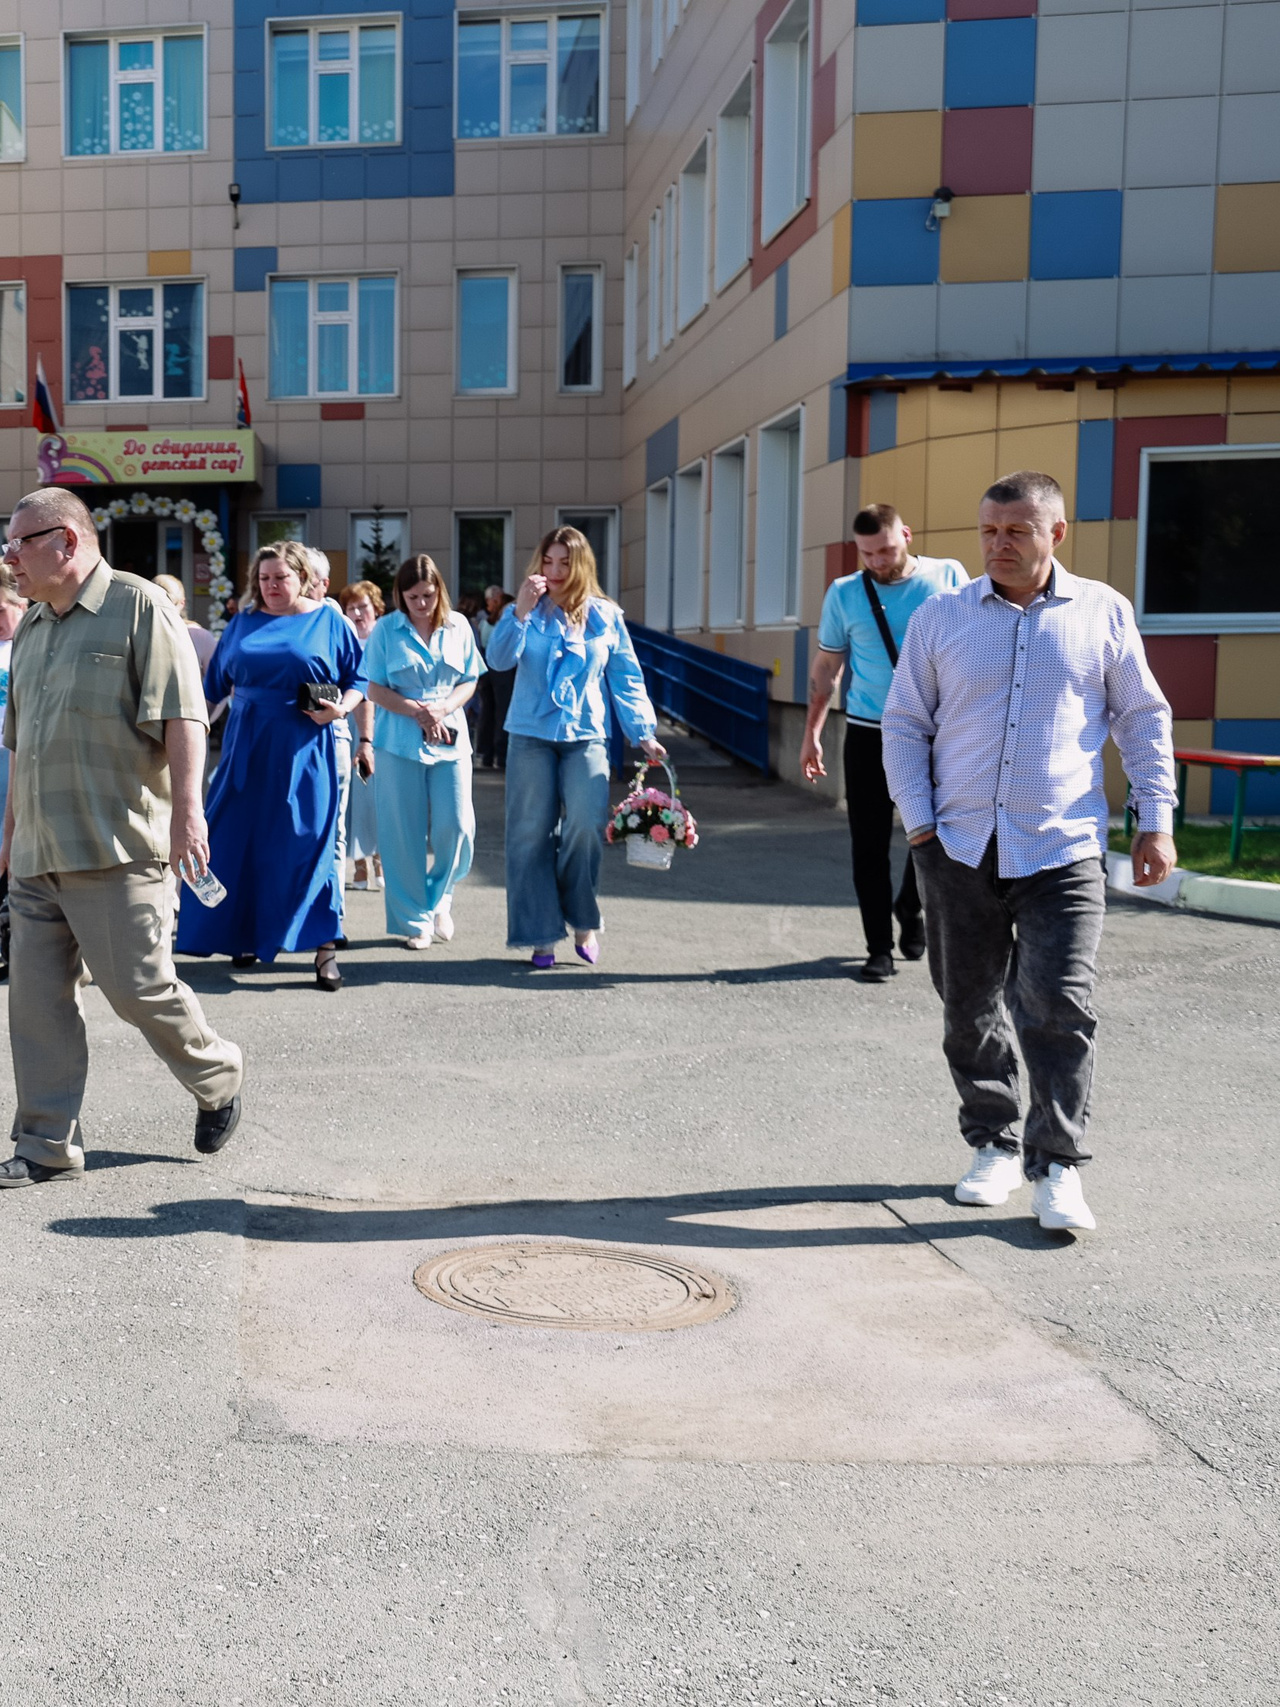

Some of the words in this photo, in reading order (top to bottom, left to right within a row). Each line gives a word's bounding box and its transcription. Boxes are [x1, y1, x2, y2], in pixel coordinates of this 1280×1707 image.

[123, 439, 146, 455] До
[152, 439, 242, 458] свидания,
[141, 456, 207, 474] детский
[210, 455, 244, 473] сад!
